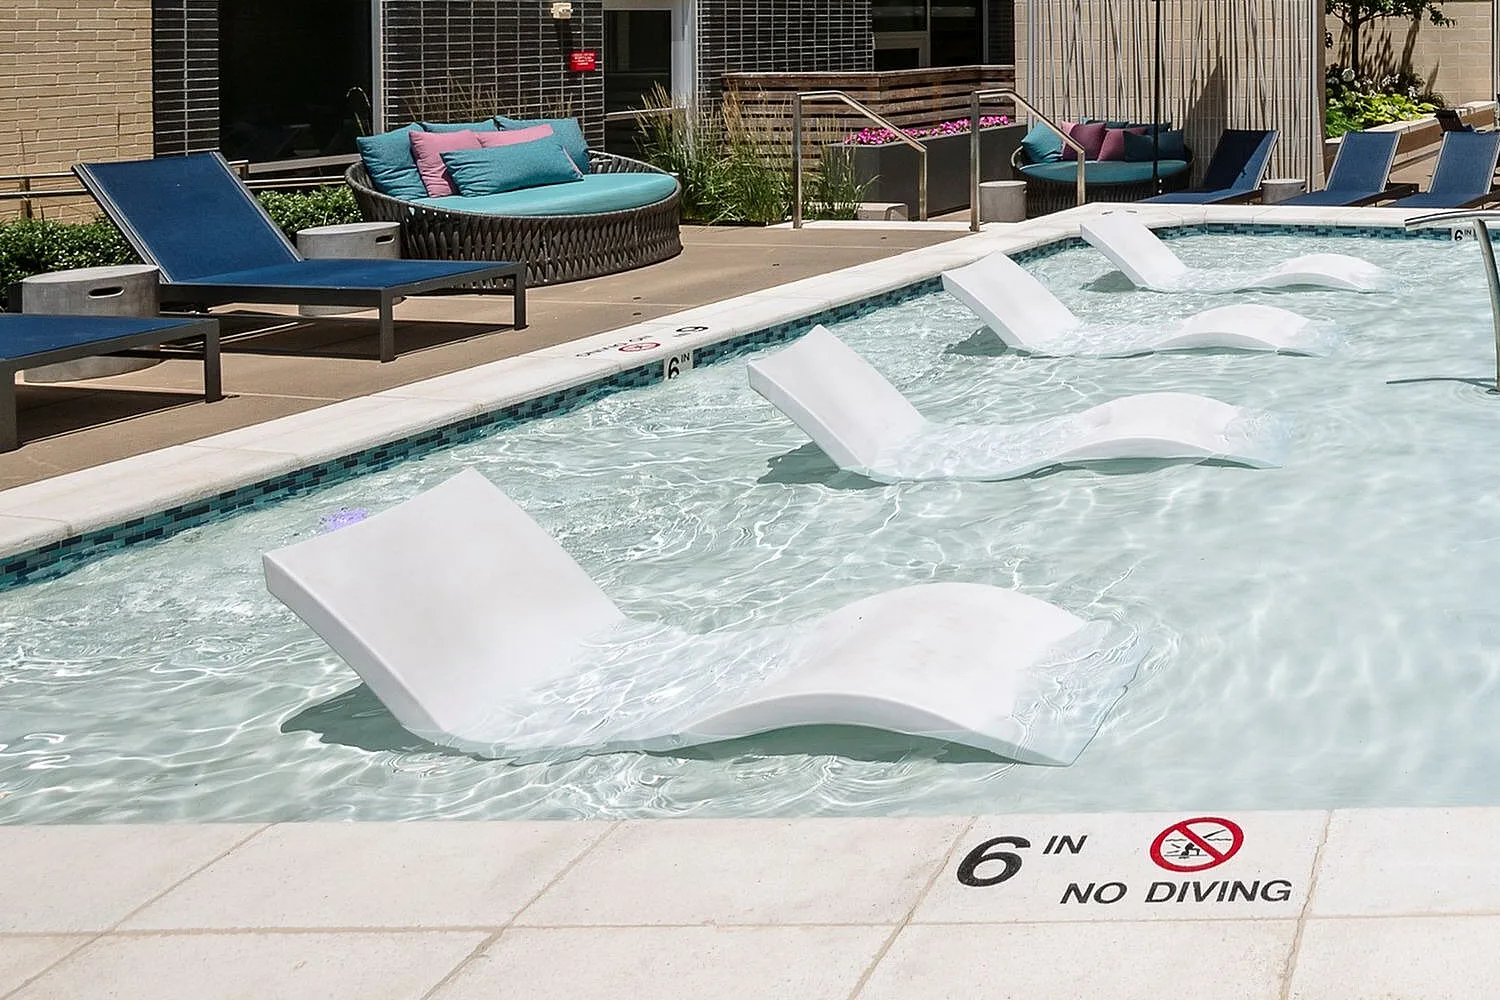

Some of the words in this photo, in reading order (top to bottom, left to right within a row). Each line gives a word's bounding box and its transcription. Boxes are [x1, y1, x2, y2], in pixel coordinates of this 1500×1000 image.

[1454, 229, 1464, 241] 6
[668, 356, 680, 380] 6
[681, 352, 691, 363] IN
[956, 835, 1032, 888] 6
[1042, 834, 1088, 855] IN
[1060, 881, 1129, 905] NO
[1144, 879, 1293, 904] DIVING
